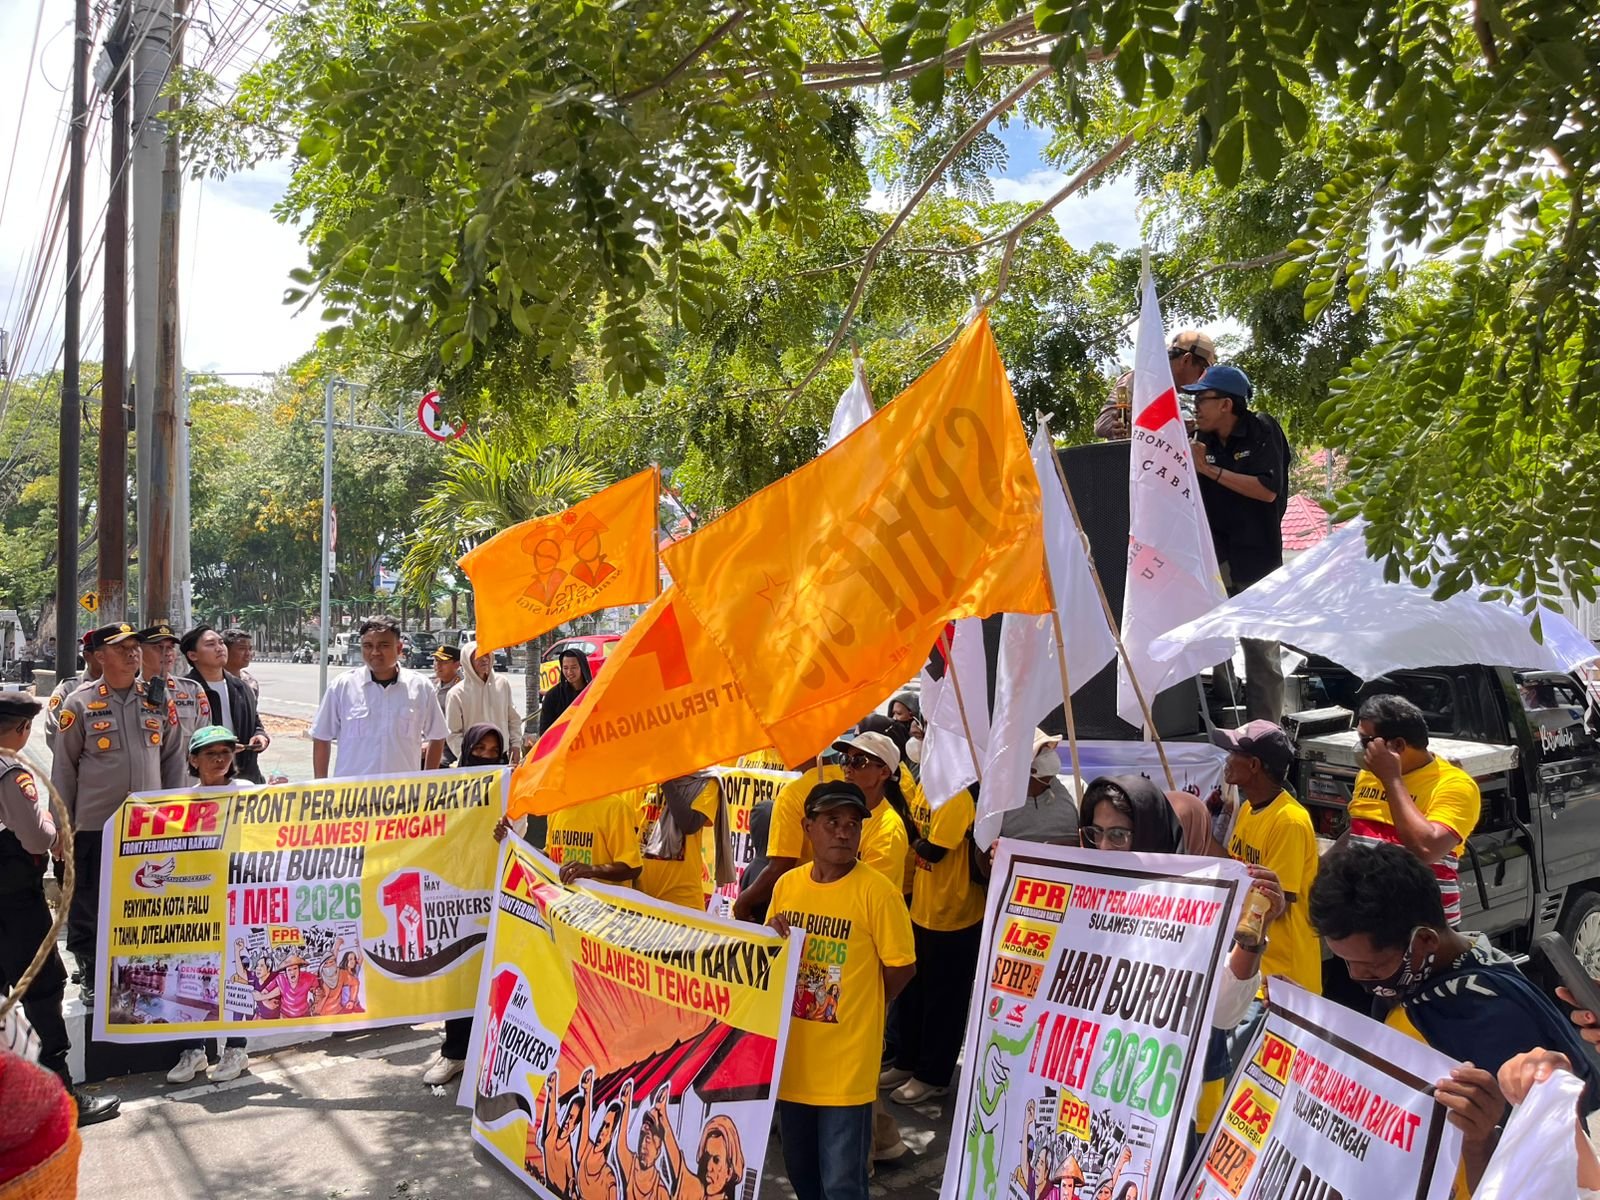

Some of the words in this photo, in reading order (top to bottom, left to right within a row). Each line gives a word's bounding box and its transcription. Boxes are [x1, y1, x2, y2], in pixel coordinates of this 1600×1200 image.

[1142, 460, 1191, 500] CABA
[232, 791, 297, 825] FRONT
[299, 783, 422, 821] PERJUANGAN
[422, 775, 494, 813] RAKYAT
[128, 802, 219, 837] FPR
[276, 821, 369, 848] SULAWESI
[374, 813, 446, 841] TENGAH
[228, 850, 282, 884] HARI
[286, 845, 365, 881] BURUH
[424, 881, 440, 891] MAY
[1014, 879, 1066, 909] FPR
[123, 897, 162, 918] PENYINTAS
[162, 896, 185, 916] KOTA
[187, 895, 210, 915] PALU
[227, 889, 237, 925] 1
[243, 886, 289, 925] MEI
[295, 883, 361, 922] 2026
[424, 896, 494, 918] WORKERS'
[1070, 884, 1106, 911] FRONT
[1104, 889, 1172, 920] PERJUANGAN
[1172, 898, 1222, 927] RAKYAT
[141, 922, 211, 945] DITELANTARKAN
[272, 929, 299, 941] FPR
[426, 917, 459, 940] DAY
[806, 913, 852, 940] BURUH
[1089, 913, 1139, 935] SULAWESI
[1139, 919, 1186, 943] TENGAH
[807, 938, 847, 965] 2026
[1001, 943, 1045, 959] INDONESIA
[580, 937, 650, 991] SULAWESI
[655, 965, 730, 1017] TENGAH
[992, 957, 1032, 990] SPHP
[511, 991, 528, 1010] MAY
[1046, 948, 1112, 1012] HARI
[1101, 958, 1205, 1037] BURUH
[499, 1020, 557, 1071] WORKERS'
[493, 1045, 519, 1087] DAY
[1028, 1011, 1049, 1073] 1
[1040, 1014, 1101, 1090] MEI
[1091, 1028, 1183, 1118] 2026
[1059, 1099, 1090, 1129] FPR
[1362, 1094, 1422, 1152] RAKYAT
[1326, 1115, 1371, 1162] TENGAH
